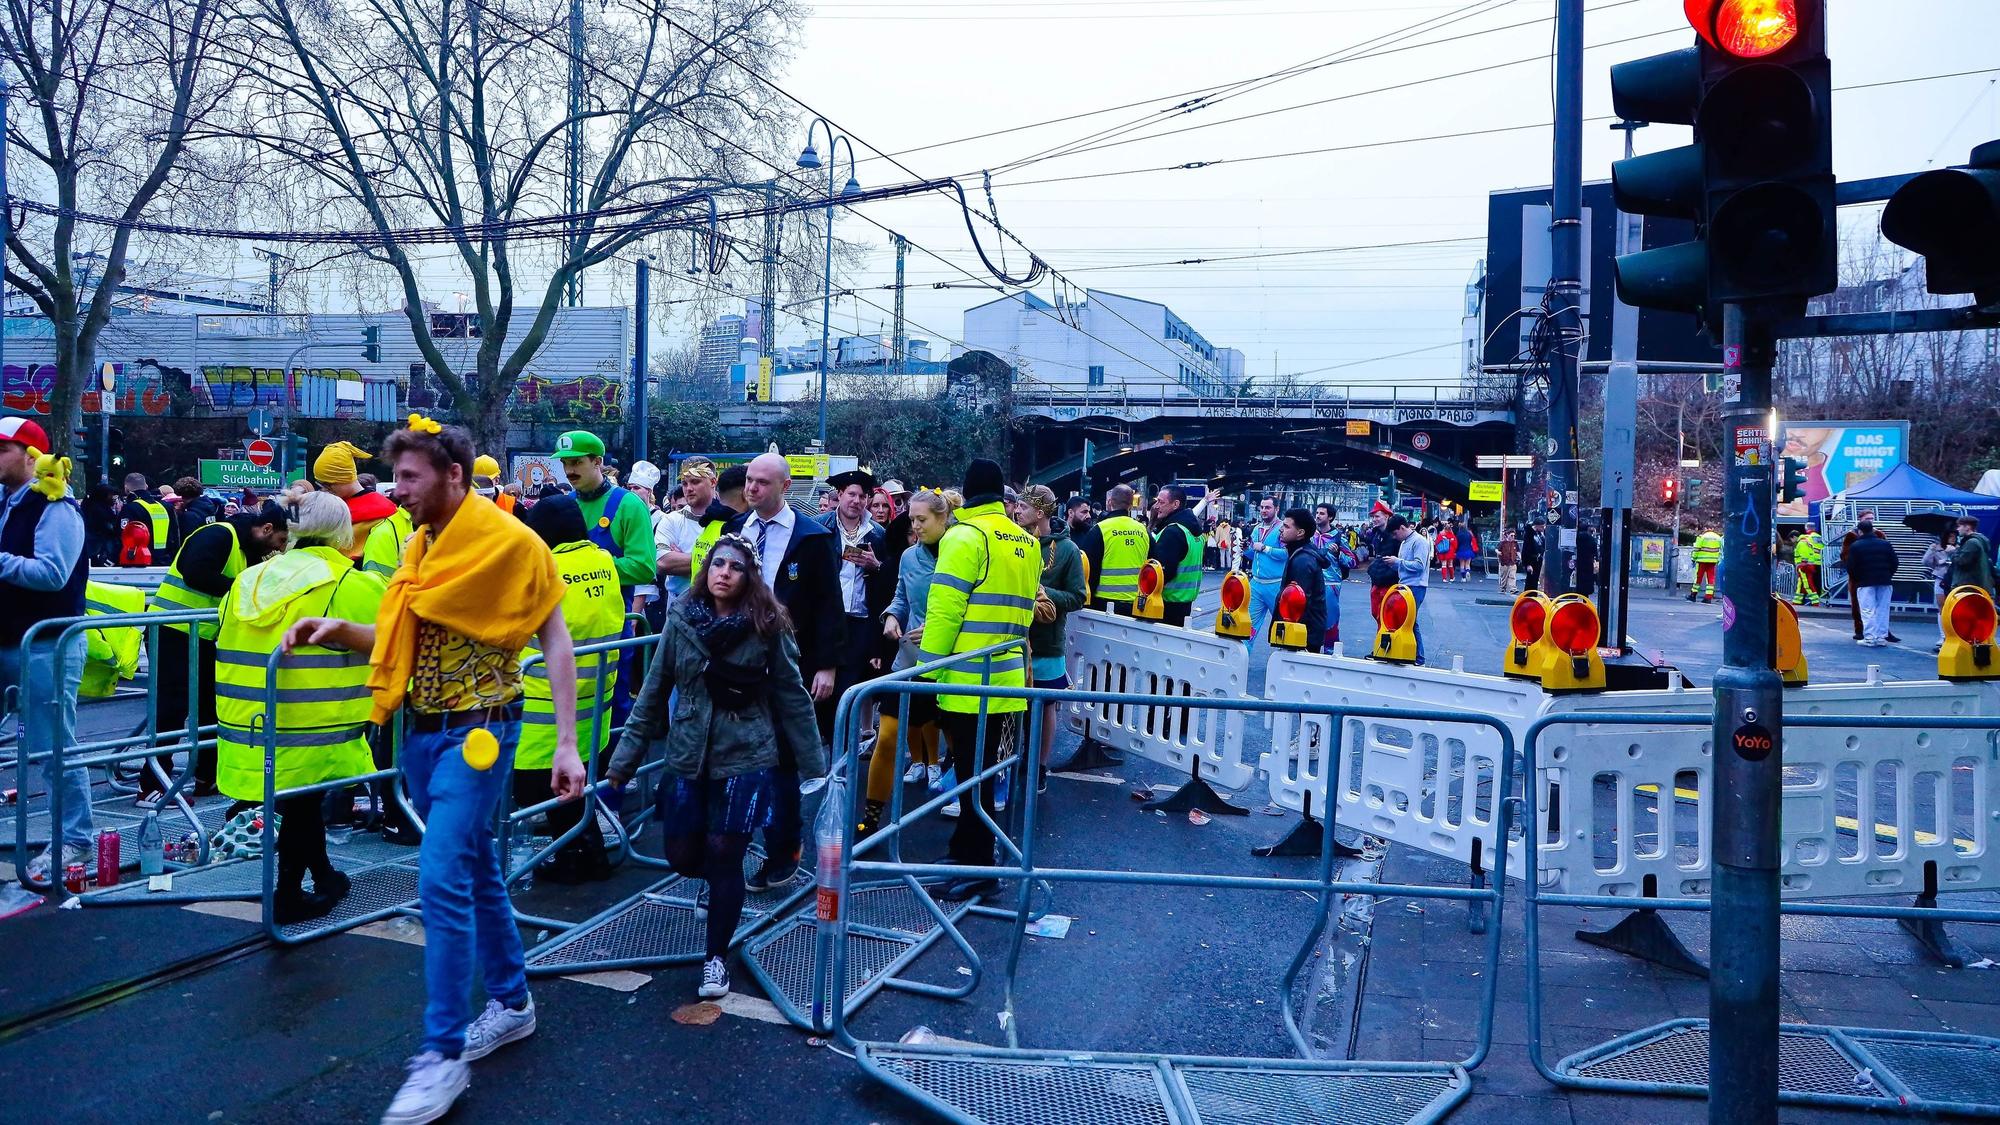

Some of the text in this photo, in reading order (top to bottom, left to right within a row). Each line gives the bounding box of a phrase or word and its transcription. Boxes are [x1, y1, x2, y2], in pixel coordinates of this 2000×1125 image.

[1315, 408, 1344, 418] MONO
[1398, 409, 1474, 422] MONO PABLO
[561, 439, 569, 448] L
[1856, 434, 1884, 445] DAS
[1844, 446, 1896, 457] BRINGT
[1854, 457, 1884, 468] NUR
[994, 530, 1034, 547] Security
[1112, 529, 1144, 538] Security
[1014, 547, 1025, 559] 40
[562, 568, 611, 584] Security
[584, 585, 604, 598] 137
[1735, 734, 1771, 749] YoYo
